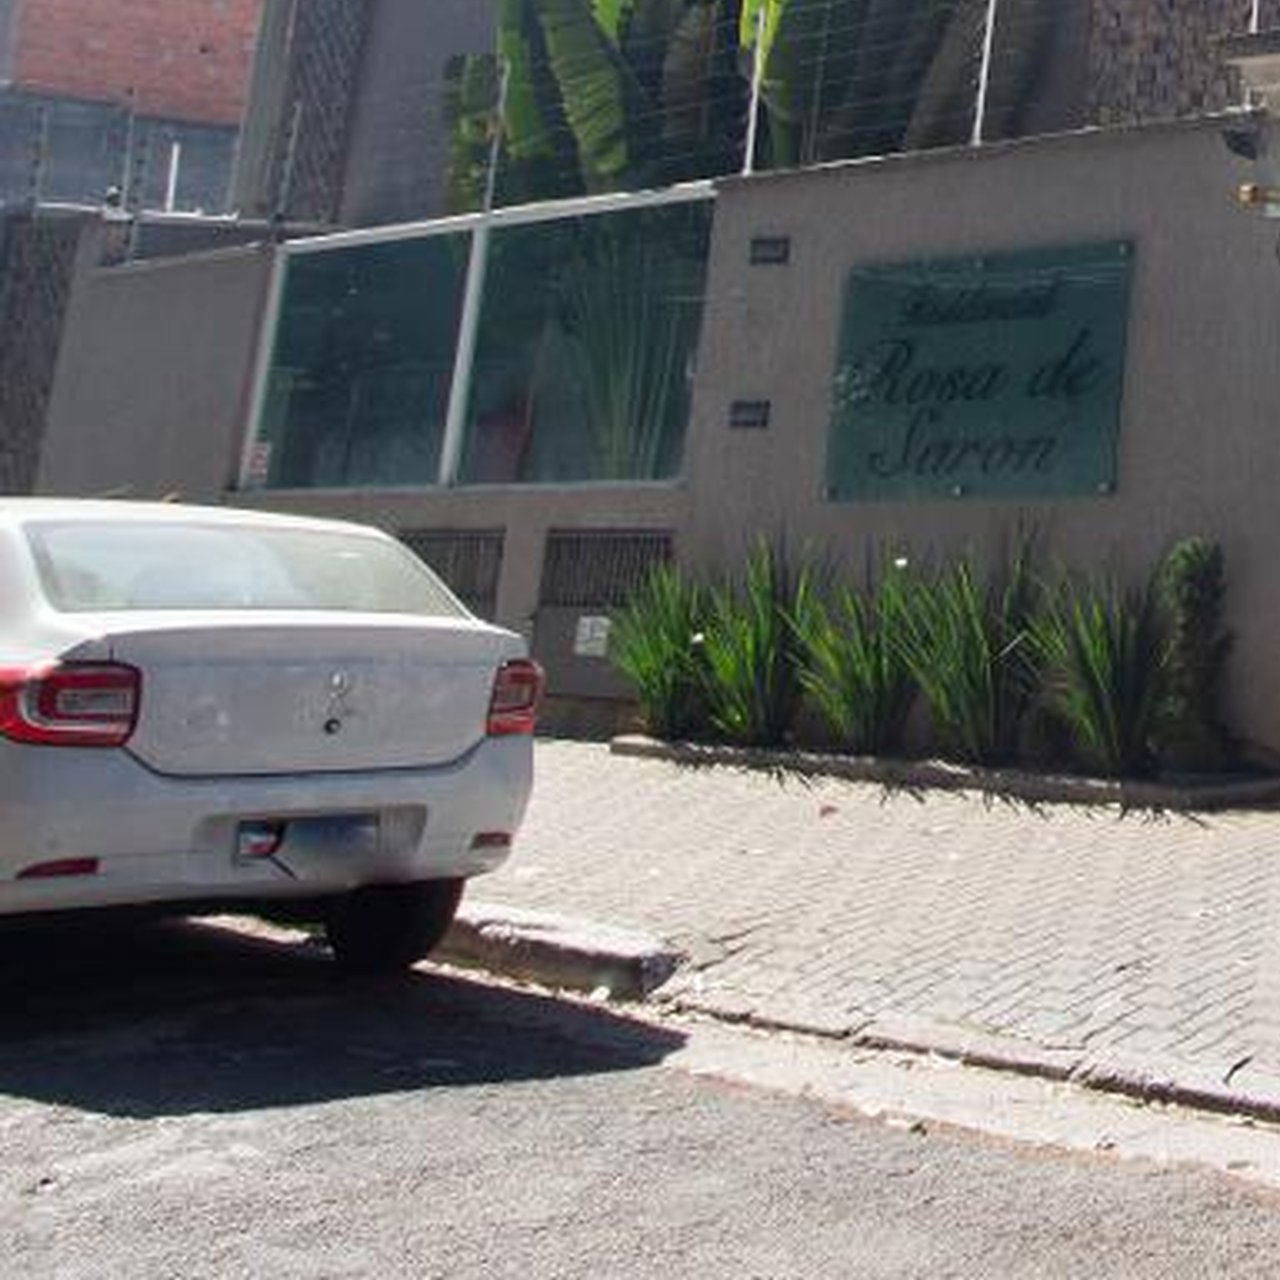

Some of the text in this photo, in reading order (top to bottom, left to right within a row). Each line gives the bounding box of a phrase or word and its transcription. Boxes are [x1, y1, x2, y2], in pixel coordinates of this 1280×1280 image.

[862, 327, 1104, 406] Rosa de
[868, 407, 1058, 478] Saron
